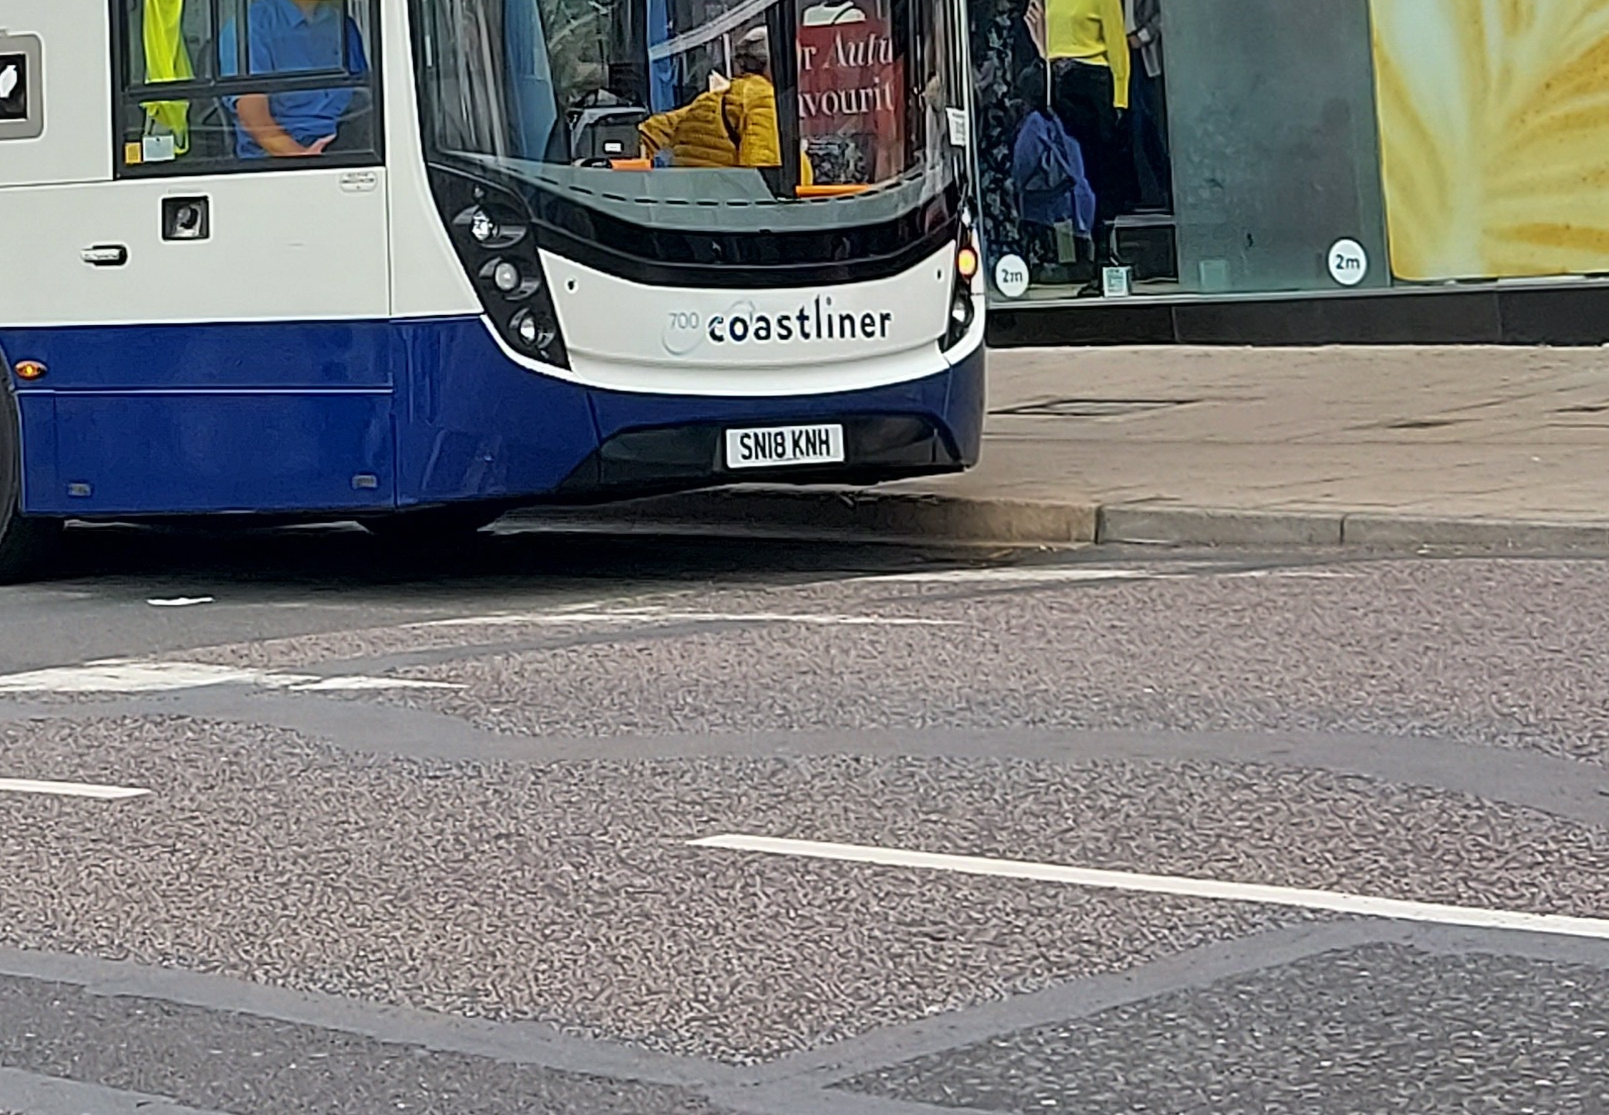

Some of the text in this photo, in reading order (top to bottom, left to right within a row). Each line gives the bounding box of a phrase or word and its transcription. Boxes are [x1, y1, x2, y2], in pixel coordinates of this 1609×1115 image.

[1334, 246, 1361, 271] 2m
[1000, 267, 1024, 284] 2m
[668, 293, 892, 344] 700 coastliner
[739, 427, 831, 461] SN18 KNH
